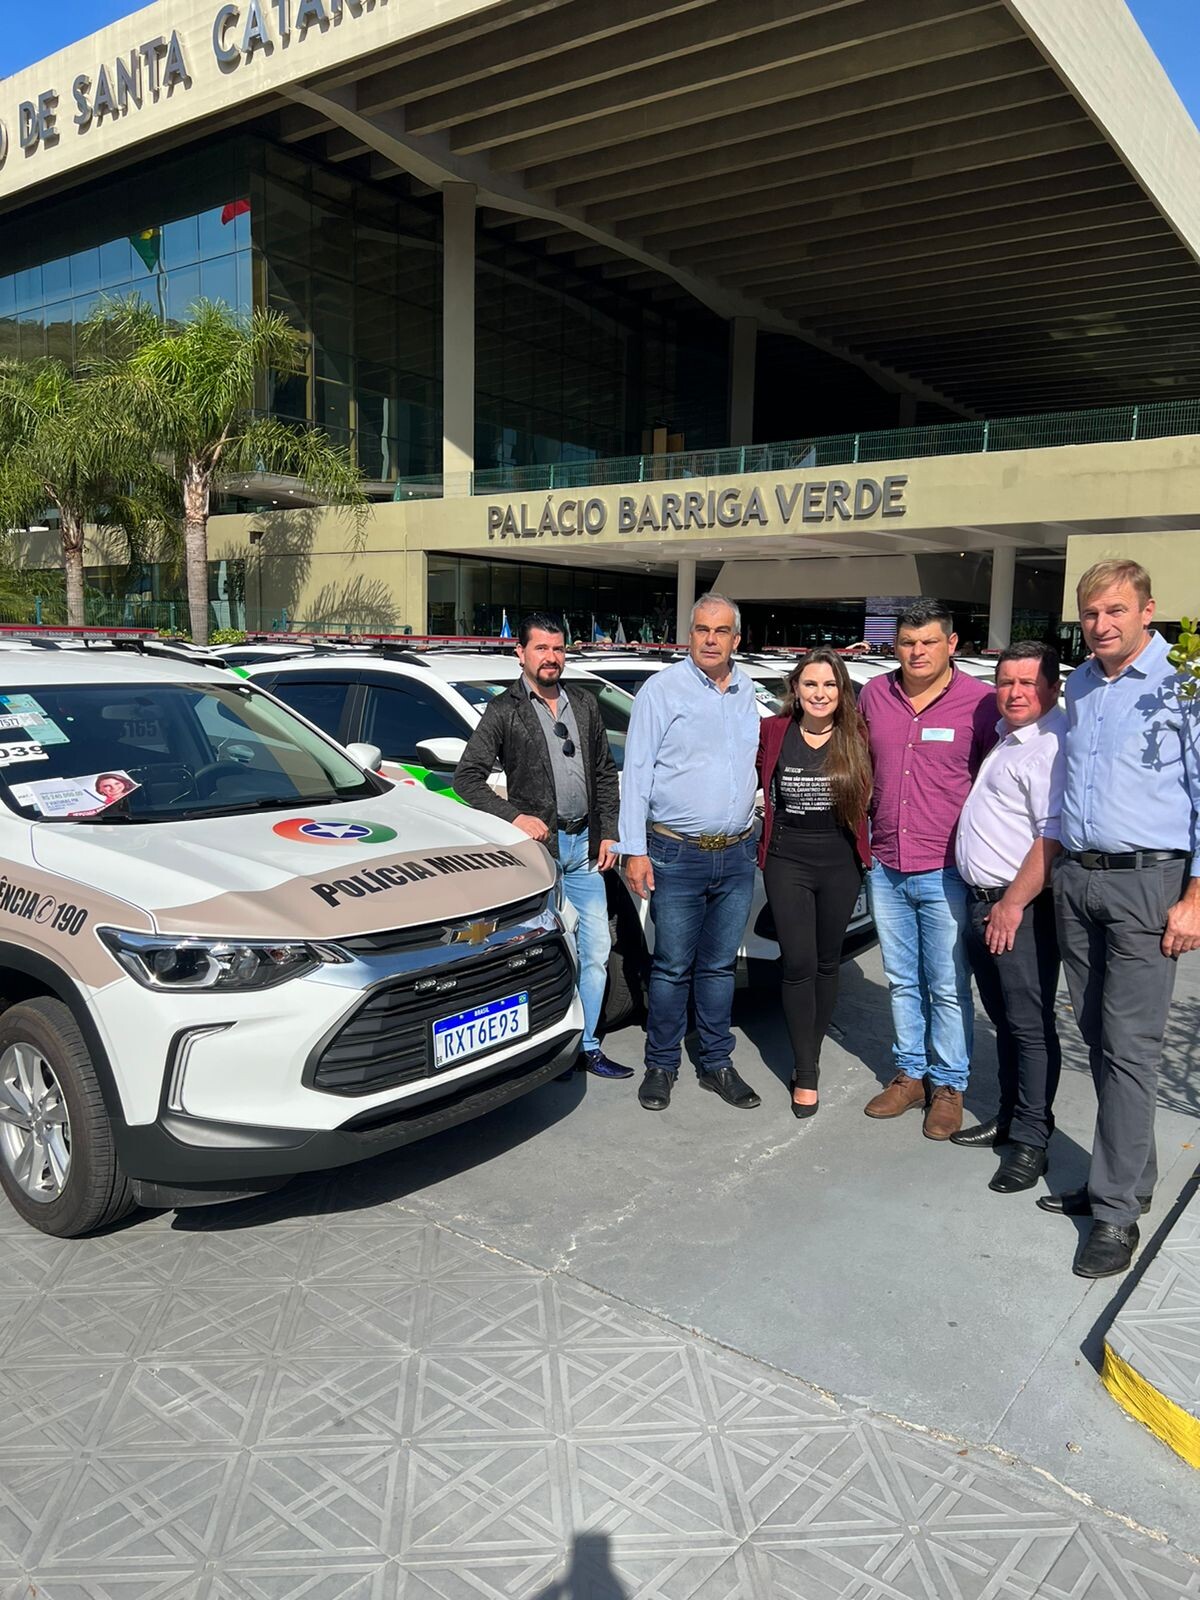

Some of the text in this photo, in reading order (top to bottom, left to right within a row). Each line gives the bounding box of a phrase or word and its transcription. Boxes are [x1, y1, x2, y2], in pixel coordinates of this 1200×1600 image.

[19, 89, 59, 153] DE
[73, 30, 190, 130] SANTA
[213, 0, 388, 68] CATA
[488, 474, 908, 538] PALÁCIO BARRIGA VERDE
[310, 850, 527, 907] POLÍCIA MILITAR
[51, 903, 88, 936] 190
[444, 1009, 519, 1058] RXT6E93
